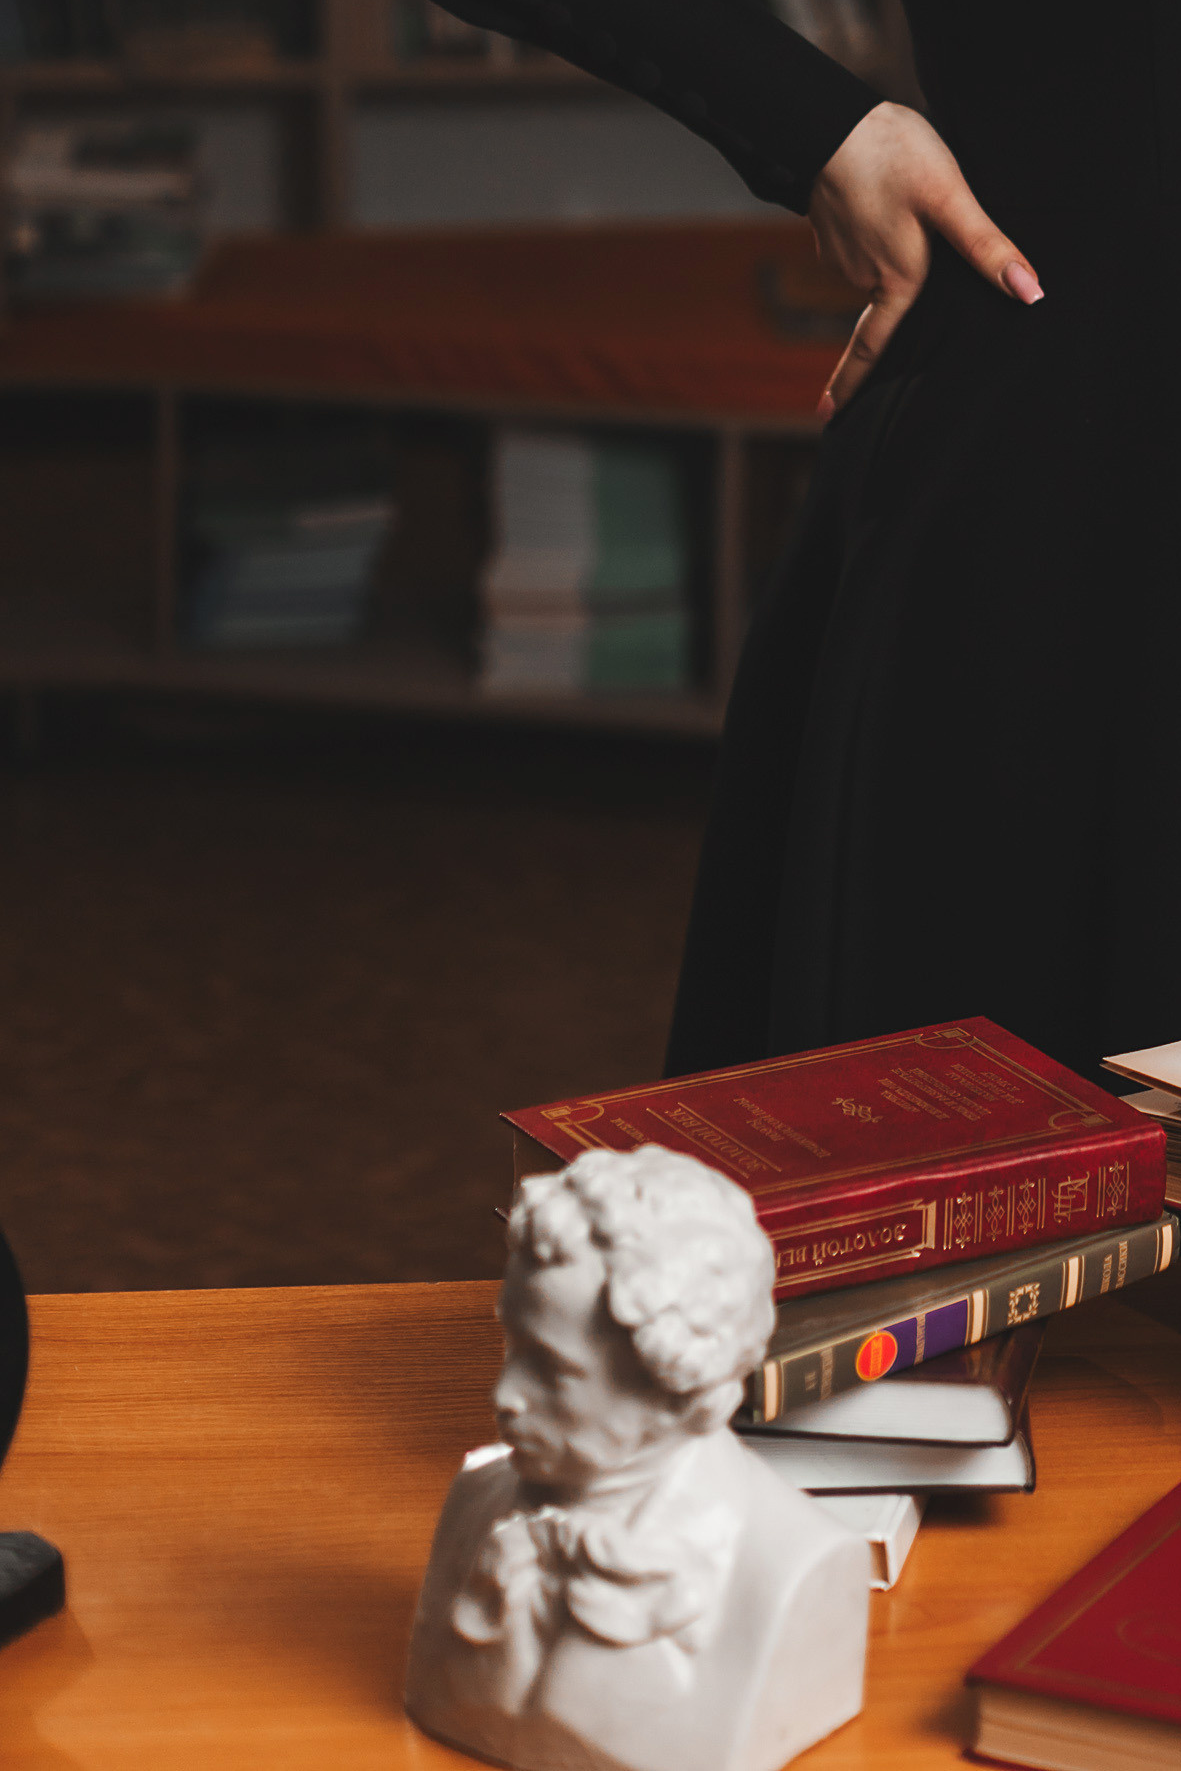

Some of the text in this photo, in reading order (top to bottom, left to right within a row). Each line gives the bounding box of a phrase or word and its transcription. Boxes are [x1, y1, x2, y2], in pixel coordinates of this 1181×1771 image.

[662, 1107, 771, 1172] ЗОЛОТОЙ ВЕК
[811, 1223, 907, 1266] ЗОЛОТОЙ
